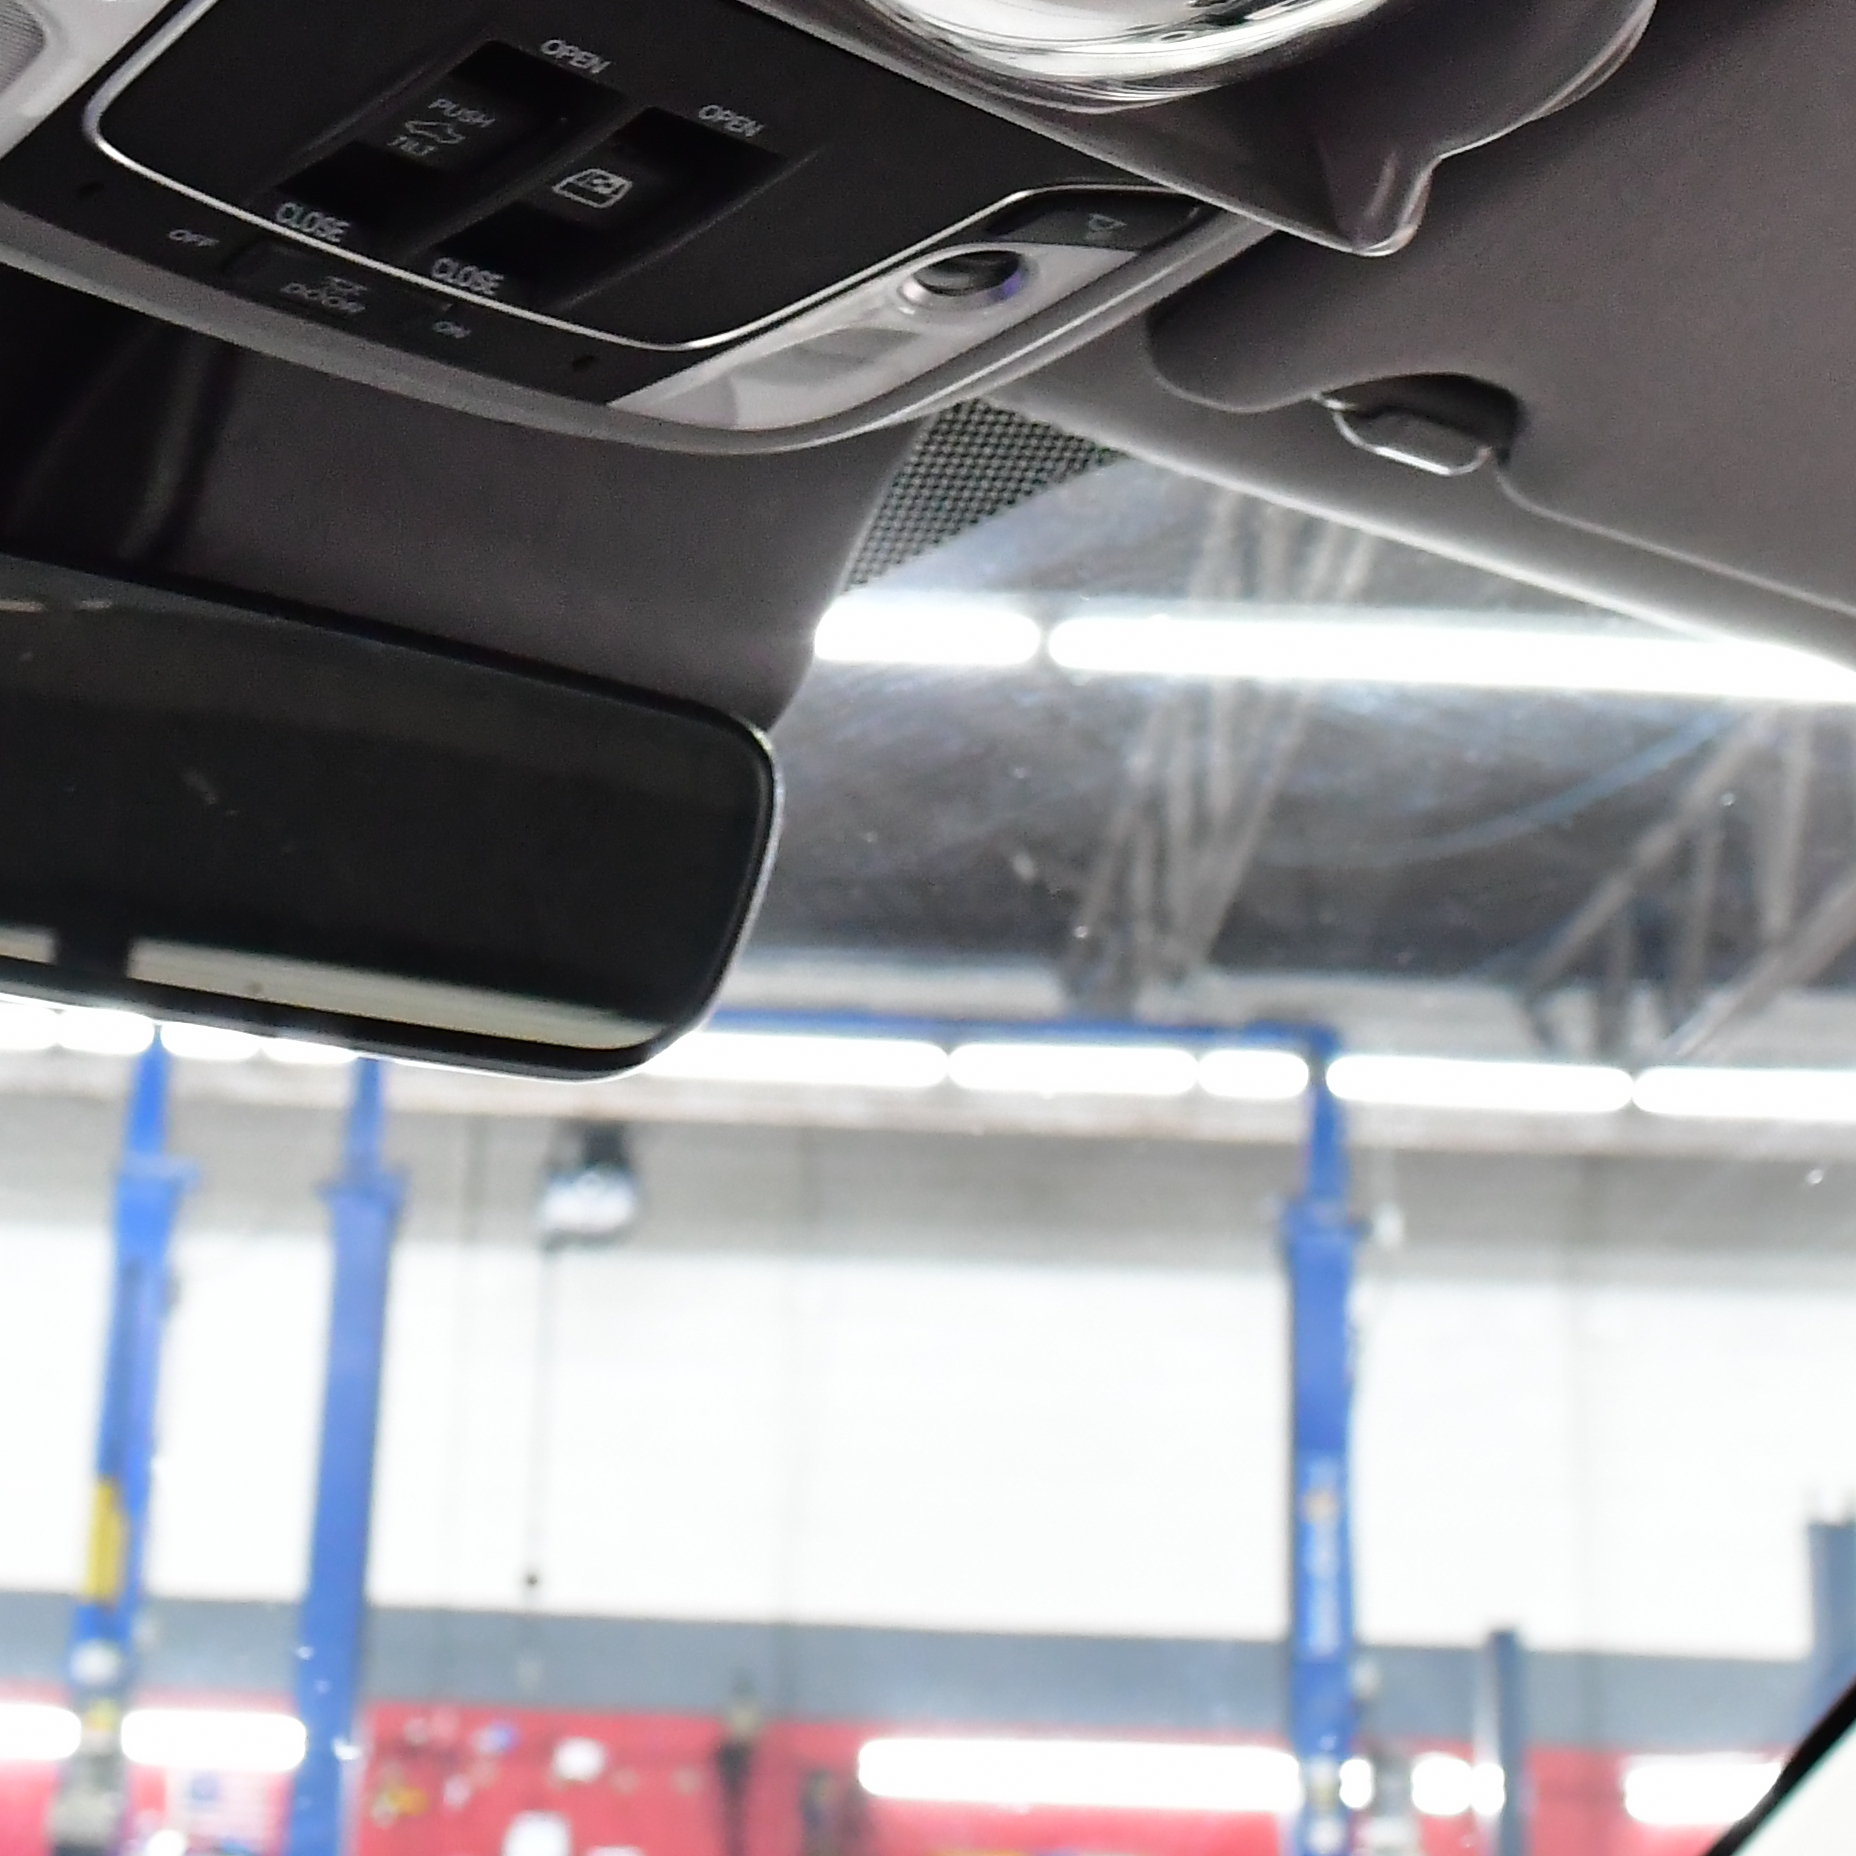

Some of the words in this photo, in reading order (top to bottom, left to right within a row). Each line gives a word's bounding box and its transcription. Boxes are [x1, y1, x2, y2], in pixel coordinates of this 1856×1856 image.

[541, 38, 612, 74] OPEN
[427, 97, 496, 128] PUSH
[697, 103, 766, 138] OPEN
[167, 229, 219, 246] OFF
[275, 201, 350, 243] CLOSE
[431, 257, 504, 295] CLOSE
[432, 320, 472, 339] ON
